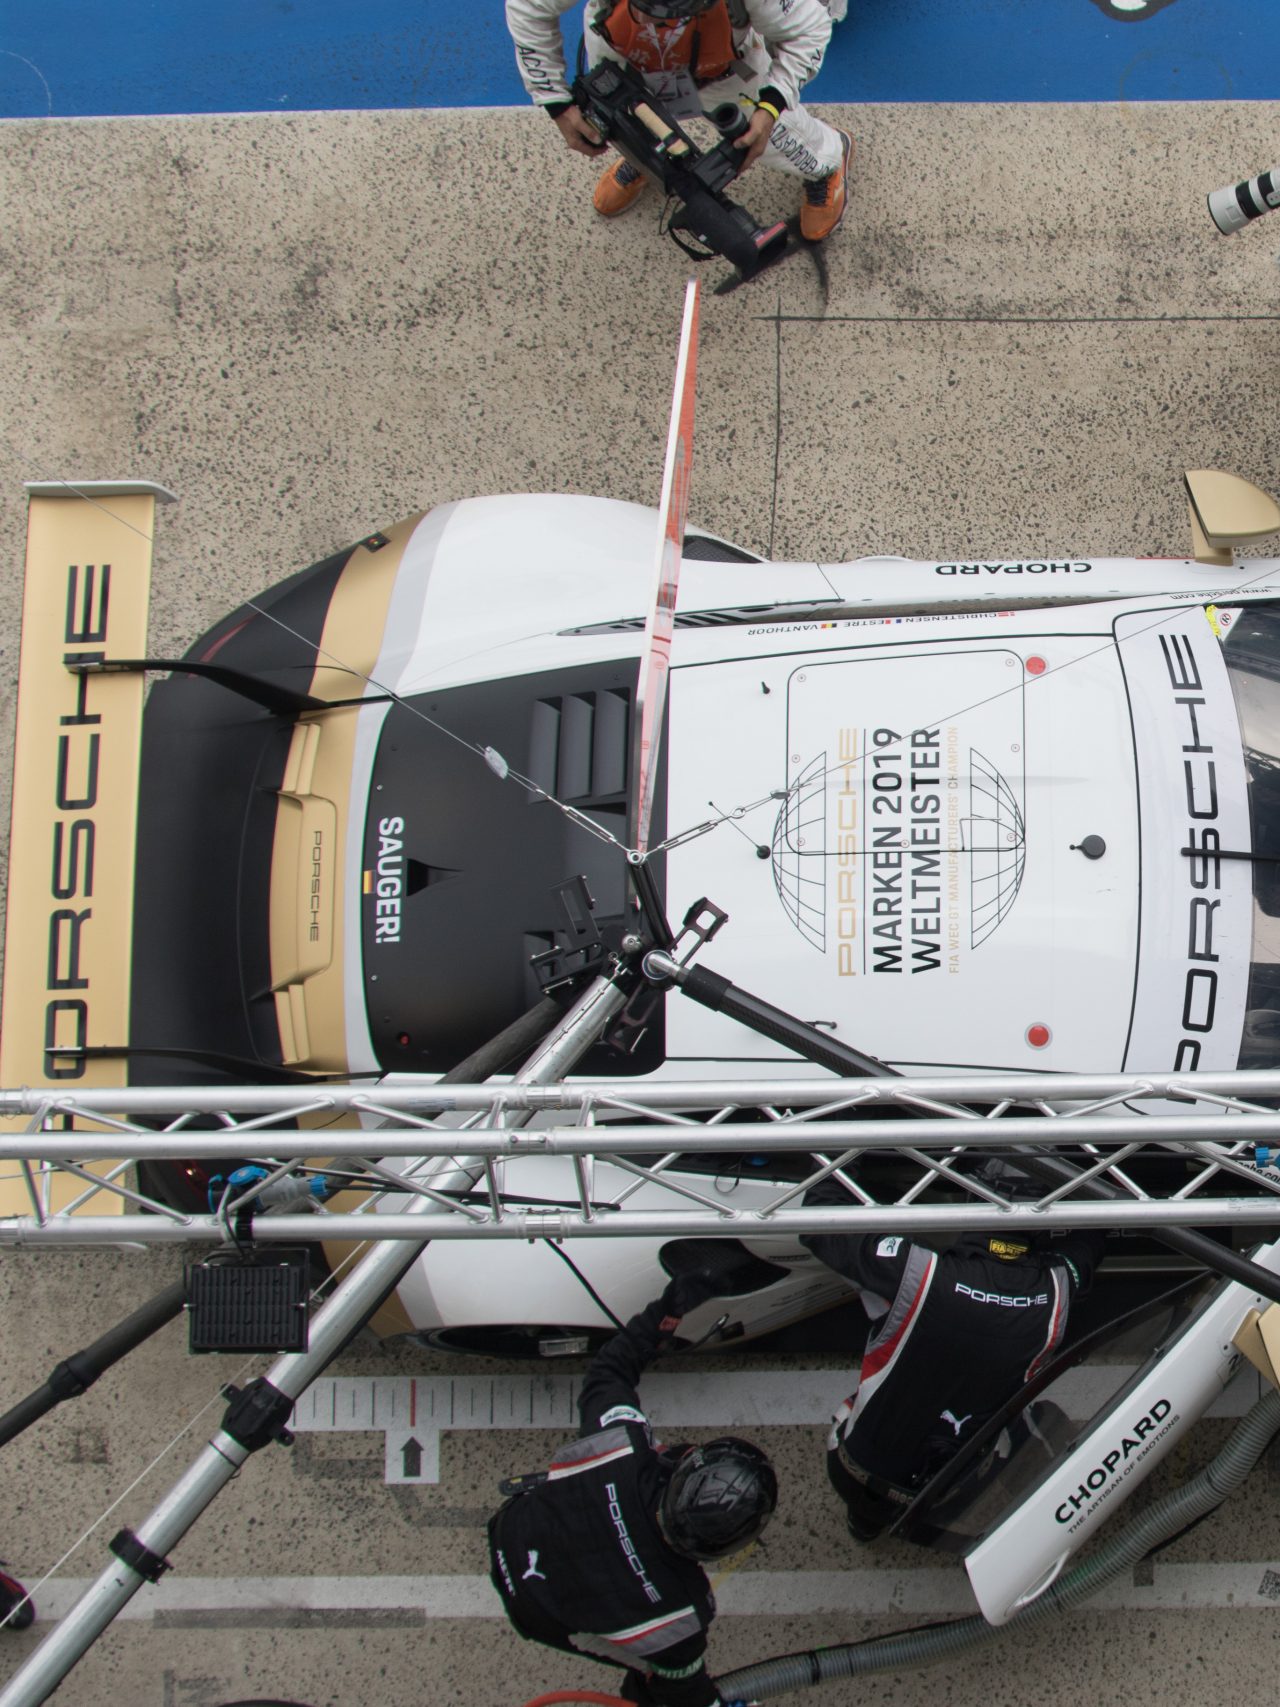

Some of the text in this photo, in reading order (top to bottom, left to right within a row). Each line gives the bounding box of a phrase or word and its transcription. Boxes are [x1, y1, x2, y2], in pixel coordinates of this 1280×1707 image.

[748, 612, 998, 636] CHRISTENSEN ESTRE VANTHOOR
[935, 562, 1092, 576] CHOPARD
[947, 727, 959, 789] CHAMPION
[41, 564, 111, 1172] ORSCHE
[309, 831, 323, 942] PORSCHE
[375, 816, 405, 944] SAUGER!
[837, 728, 857, 976] PORSCHE
[872, 728, 902, 973] MARKEN 2019
[910, 728, 941, 974] WELTMEISTER
[948, 922, 960, 950] WEC
[949, 953, 960, 974] FIA
[955, 1282, 1048, 1307] PORSCHE
[1055, 1399, 1172, 1524] CHOPARD
[1067, 1414, 1181, 1534] THE ARTISAN OF EMOTIONS
[605, 1483, 662, 1604] PORSCHE
